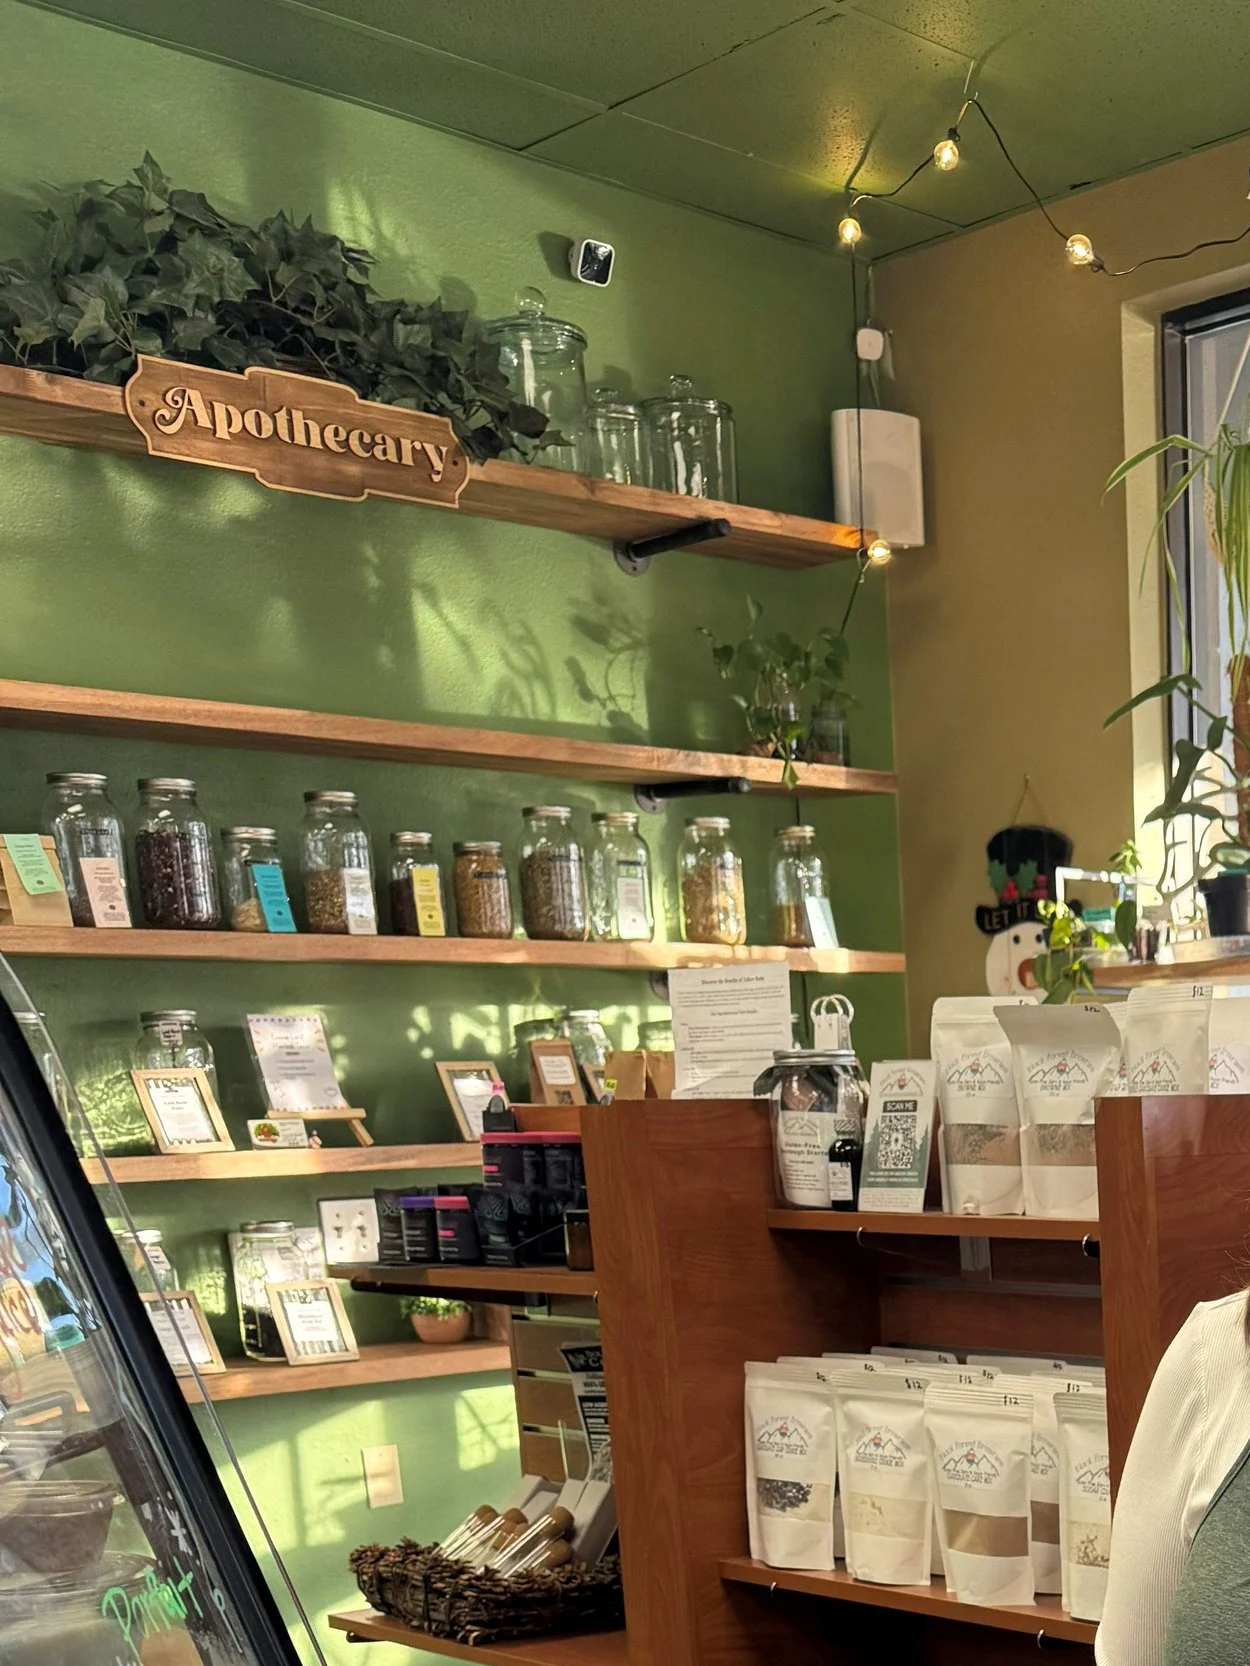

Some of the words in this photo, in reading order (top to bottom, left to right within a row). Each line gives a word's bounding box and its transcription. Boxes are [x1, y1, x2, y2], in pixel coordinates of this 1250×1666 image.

[154, 386, 448, 483] Apothecary
[886, 1101, 905, 1112] SCAN
[905, 1101, 915, 1111] ME
[905, 1378, 923, 1390] $12
[1003, 1394, 1020, 1406] $12
